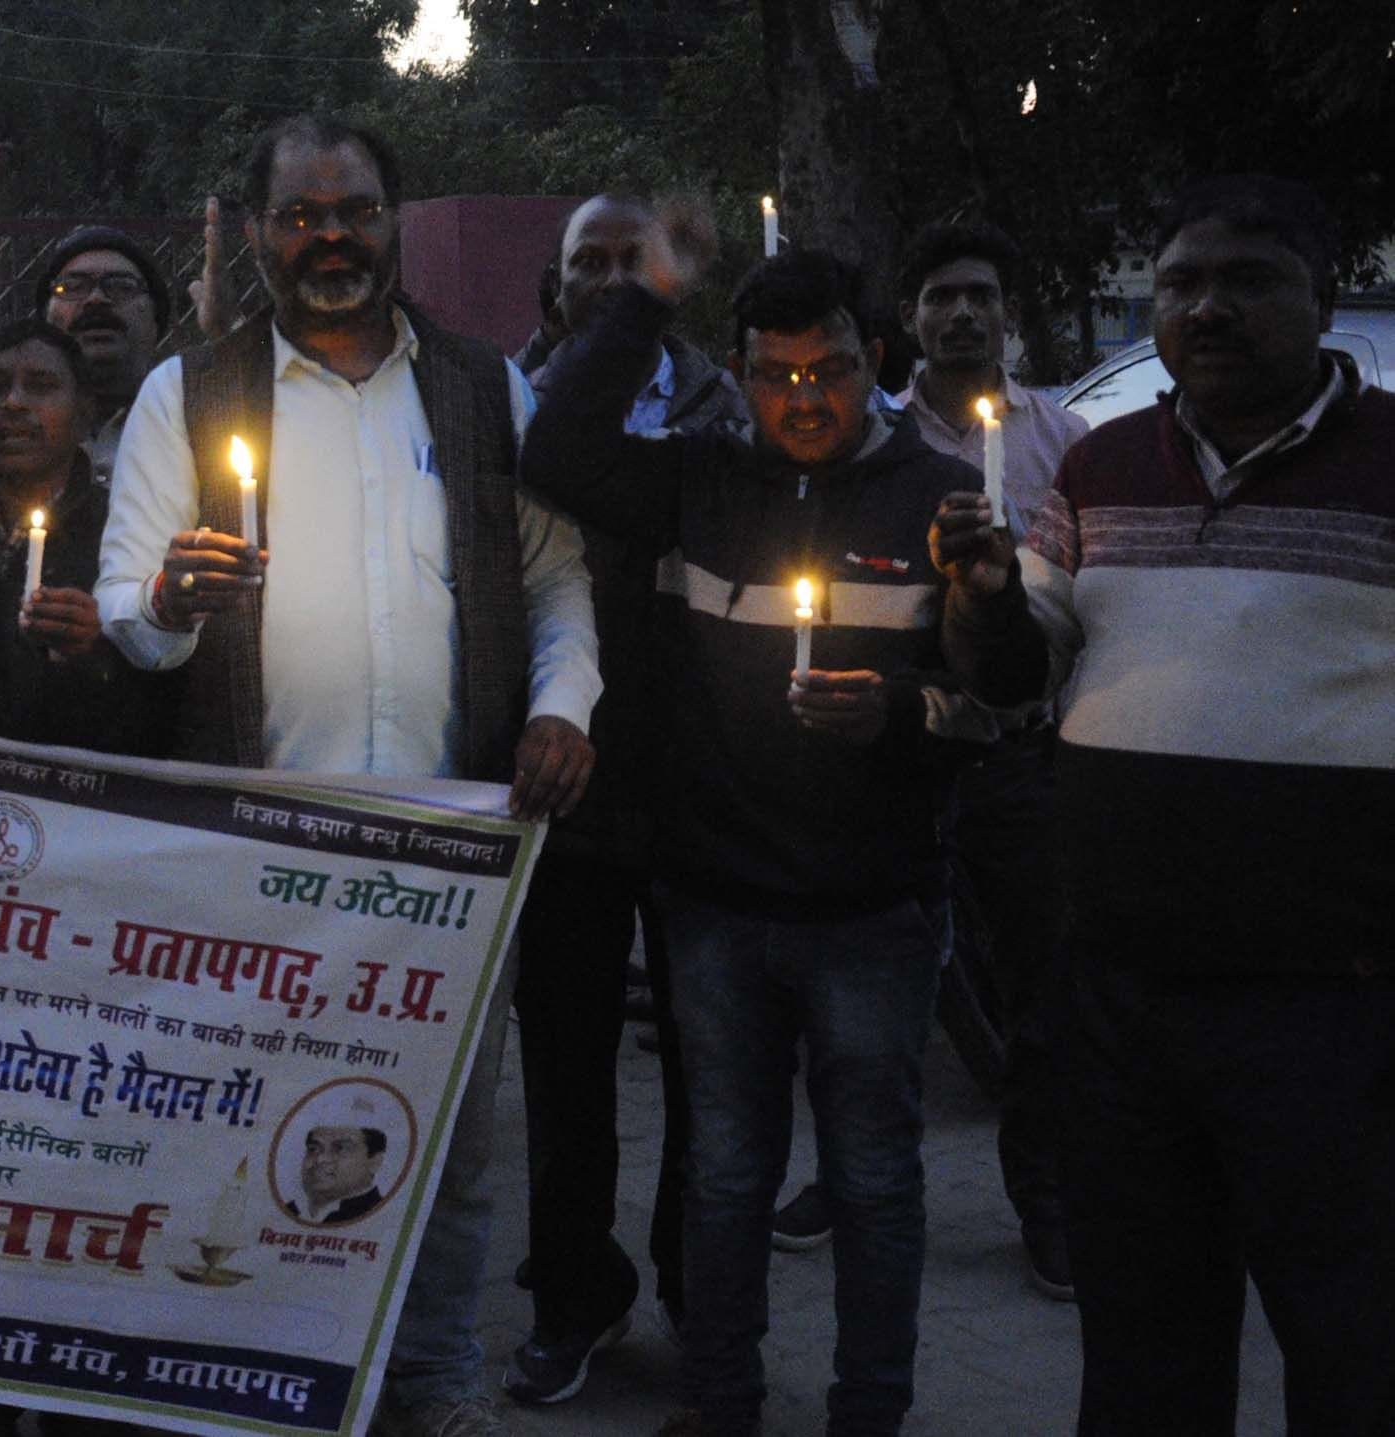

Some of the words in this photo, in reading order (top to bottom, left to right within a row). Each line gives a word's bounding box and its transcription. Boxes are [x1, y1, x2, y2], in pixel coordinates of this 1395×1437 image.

[232, 796, 291, 826] विजय
[297, 815, 352, 844] कुमार
[259, 864, 330, 905] जय
[346, 961, 448, 1024] उ.प्र.
[14, 987, 41, 1009] पर
[47, 989, 90, 1019] मरने
[97, 1003, 153, 1031] वालों
[156, 1016, 187, 1037] का
[192, 1021, 244, 1048] बाकी
[252, 1027, 286, 1055] यही
[292, 1031, 339, 1061] निशा
[82, 1044, 114, 1119] है
[117, 1050, 214, 1123] मैदान
[92, 1140, 152, 1169] बलों
[145, 1353, 316, 1412] प्रतापगढ़
